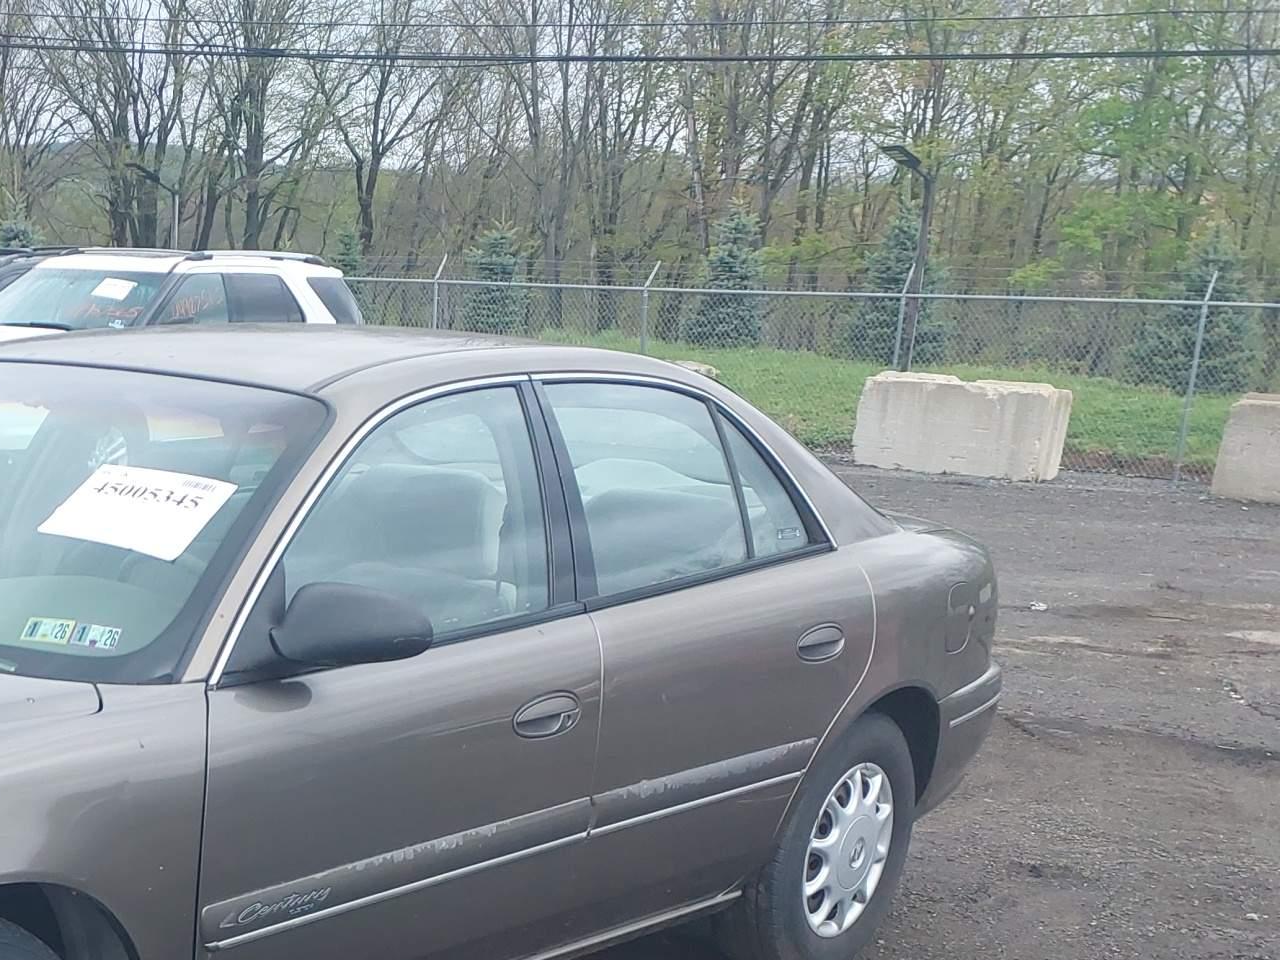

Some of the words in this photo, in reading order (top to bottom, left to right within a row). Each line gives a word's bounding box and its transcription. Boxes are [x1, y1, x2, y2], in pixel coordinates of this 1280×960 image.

[93, 481, 205, 510] 45005345
[54, 622, 70, 641] 26
[103, 629, 119, 647] 26
[238, 887, 331, 924] Century
